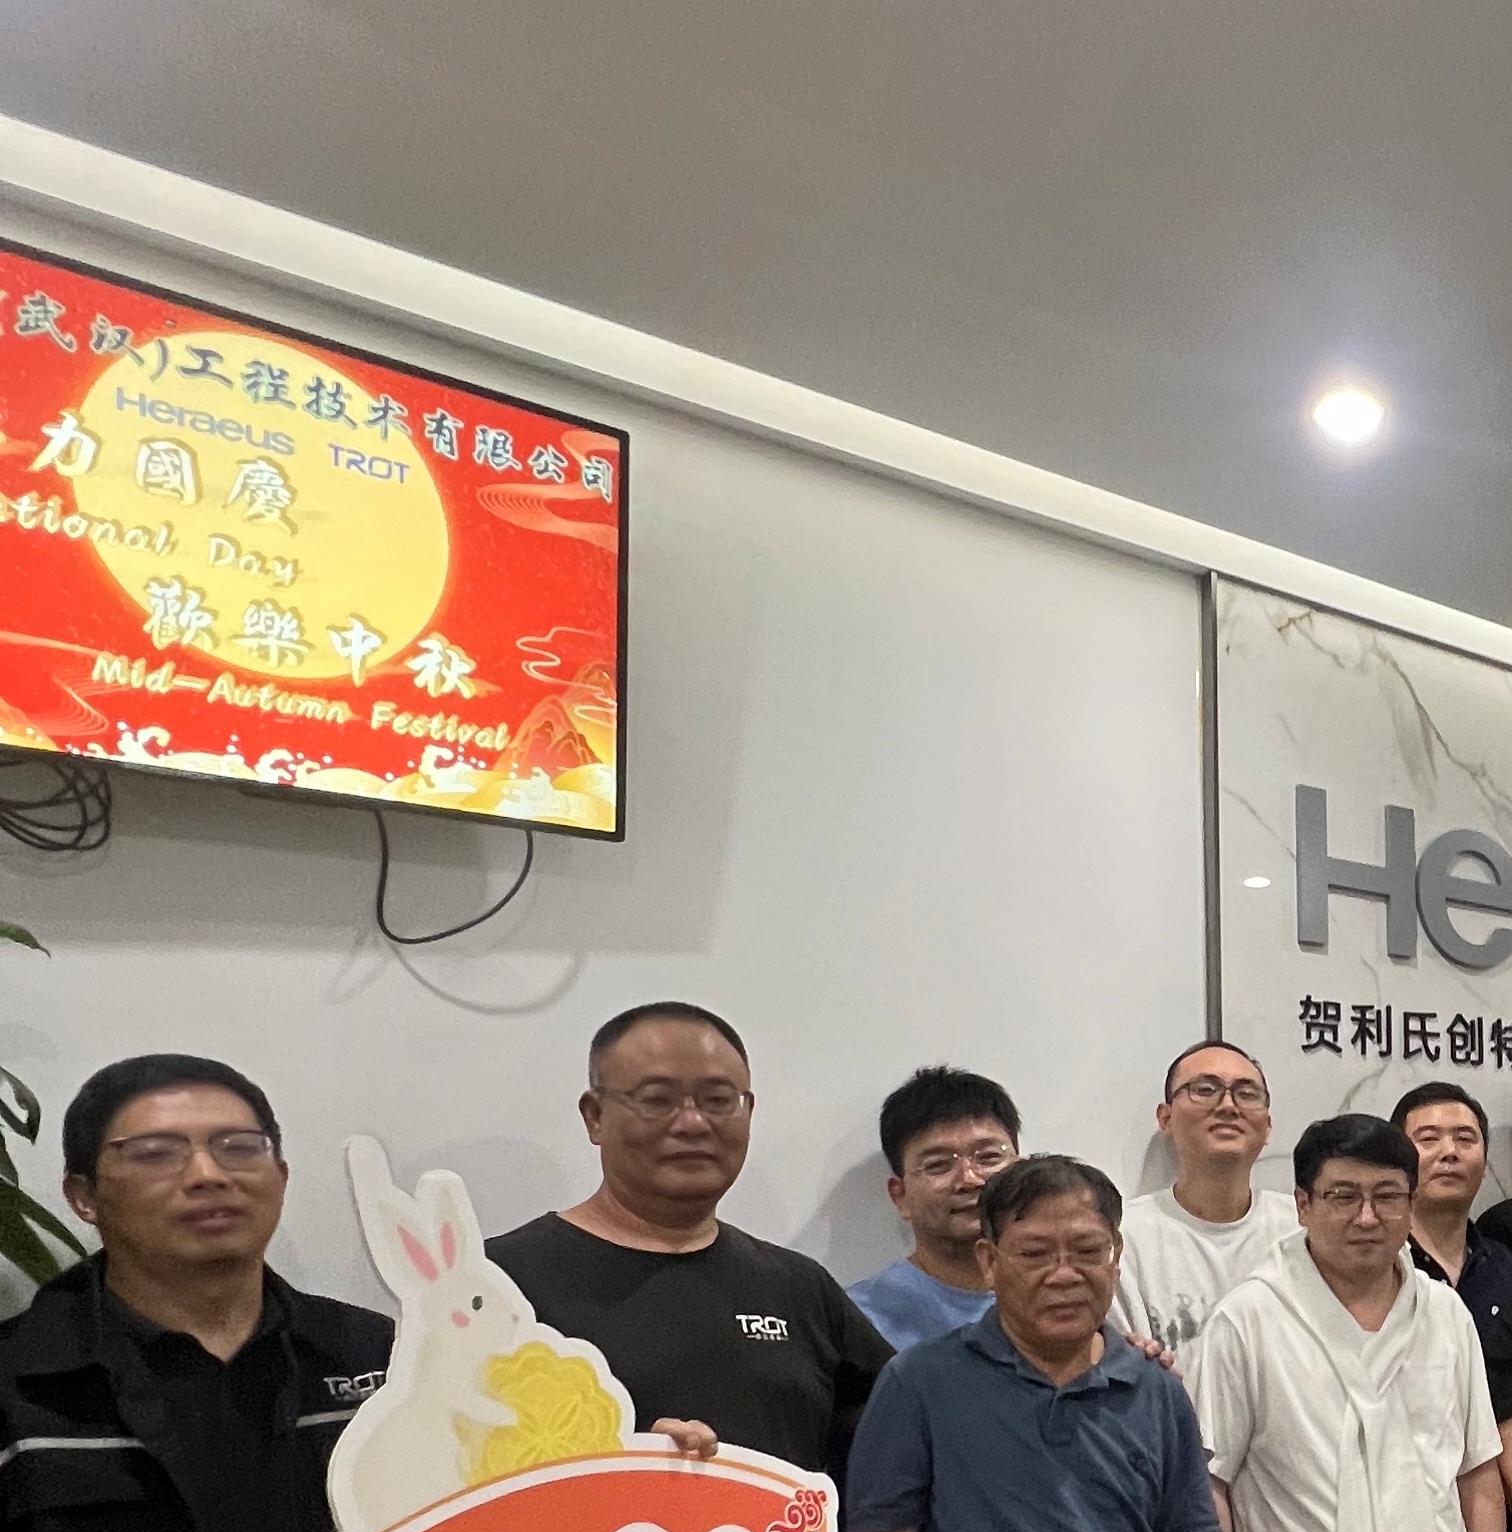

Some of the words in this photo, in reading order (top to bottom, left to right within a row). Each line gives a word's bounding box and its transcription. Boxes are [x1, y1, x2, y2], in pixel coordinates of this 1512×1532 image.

[0, 288, 613, 503] 武汉)工程技术有限公司
[116, 386, 296, 456] Heraeus
[28, 409, 300, 536] 力國慶
[327, 443, 411, 485] TROT
[0, 492, 178, 556] tional
[208, 533, 300, 589] Day
[143, 573, 478, 701] 歡樂中秋
[370, 701, 512, 752] Festival
[736, 1314, 788, 1336] TROT
